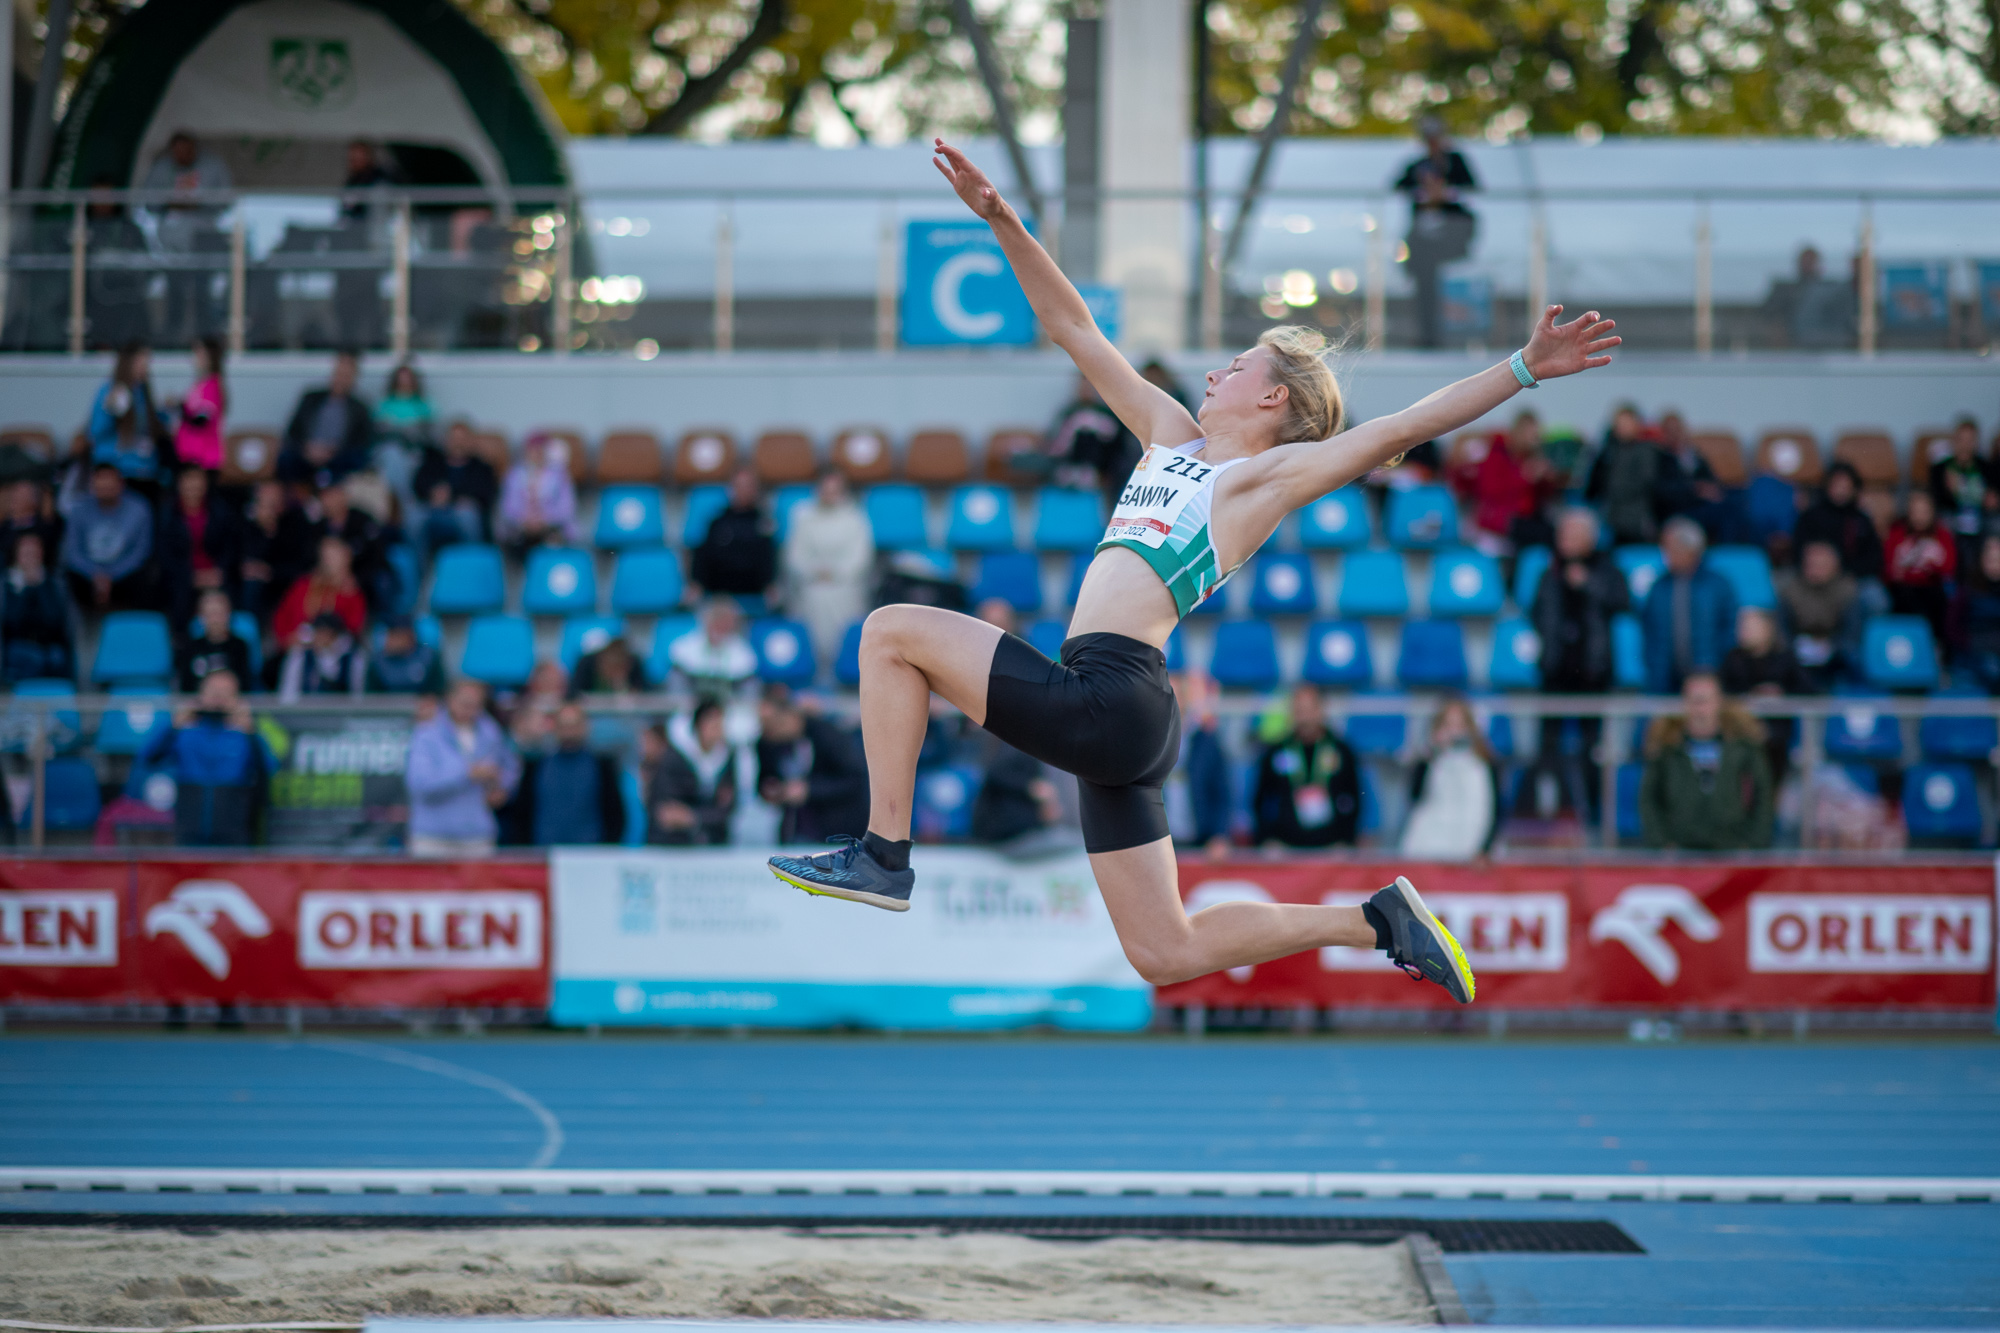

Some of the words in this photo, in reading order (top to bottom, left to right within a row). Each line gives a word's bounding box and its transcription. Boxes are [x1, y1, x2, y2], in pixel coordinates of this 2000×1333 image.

[930, 252, 1005, 339] C
[1163, 456, 1212, 483] 211
[1118, 484, 1179, 508] GAWIN
[1124, 525, 1147, 537] 2022
[319, 910, 518, 949] ORLEN
[1768, 912, 1972, 955] ORLEN
